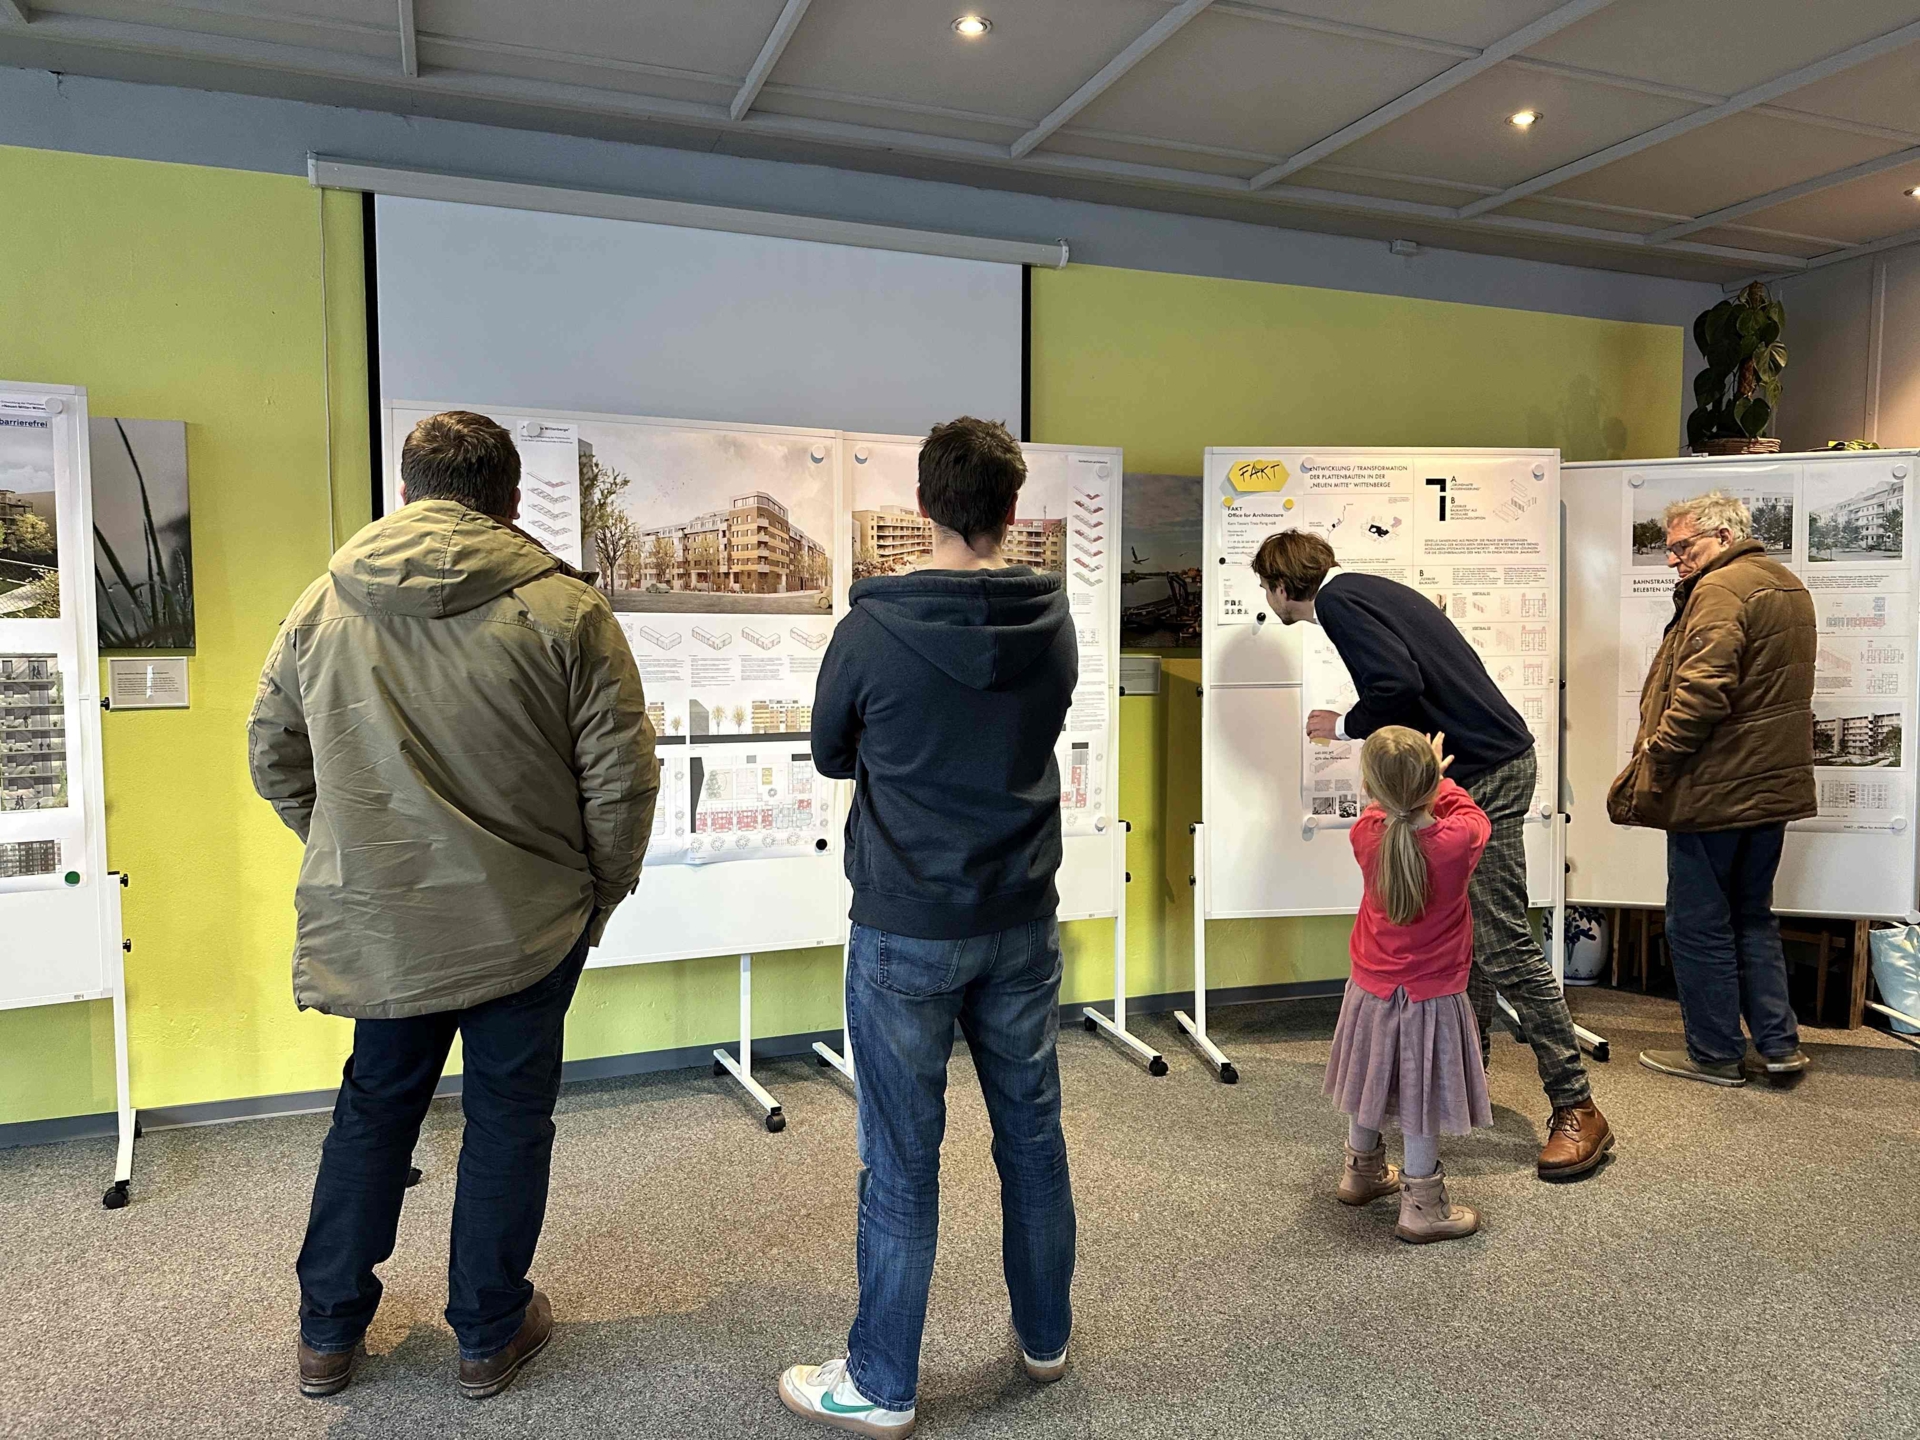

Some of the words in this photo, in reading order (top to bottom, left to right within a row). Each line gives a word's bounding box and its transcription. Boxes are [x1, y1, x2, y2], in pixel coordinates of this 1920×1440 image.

[0, 418, 48, 428] barrierefrei
[1239, 463, 1280, 483] FAKT
[1450, 475, 1457, 483] A
[1450, 496, 1456, 504] B
[1419, 569, 1424, 577] B
